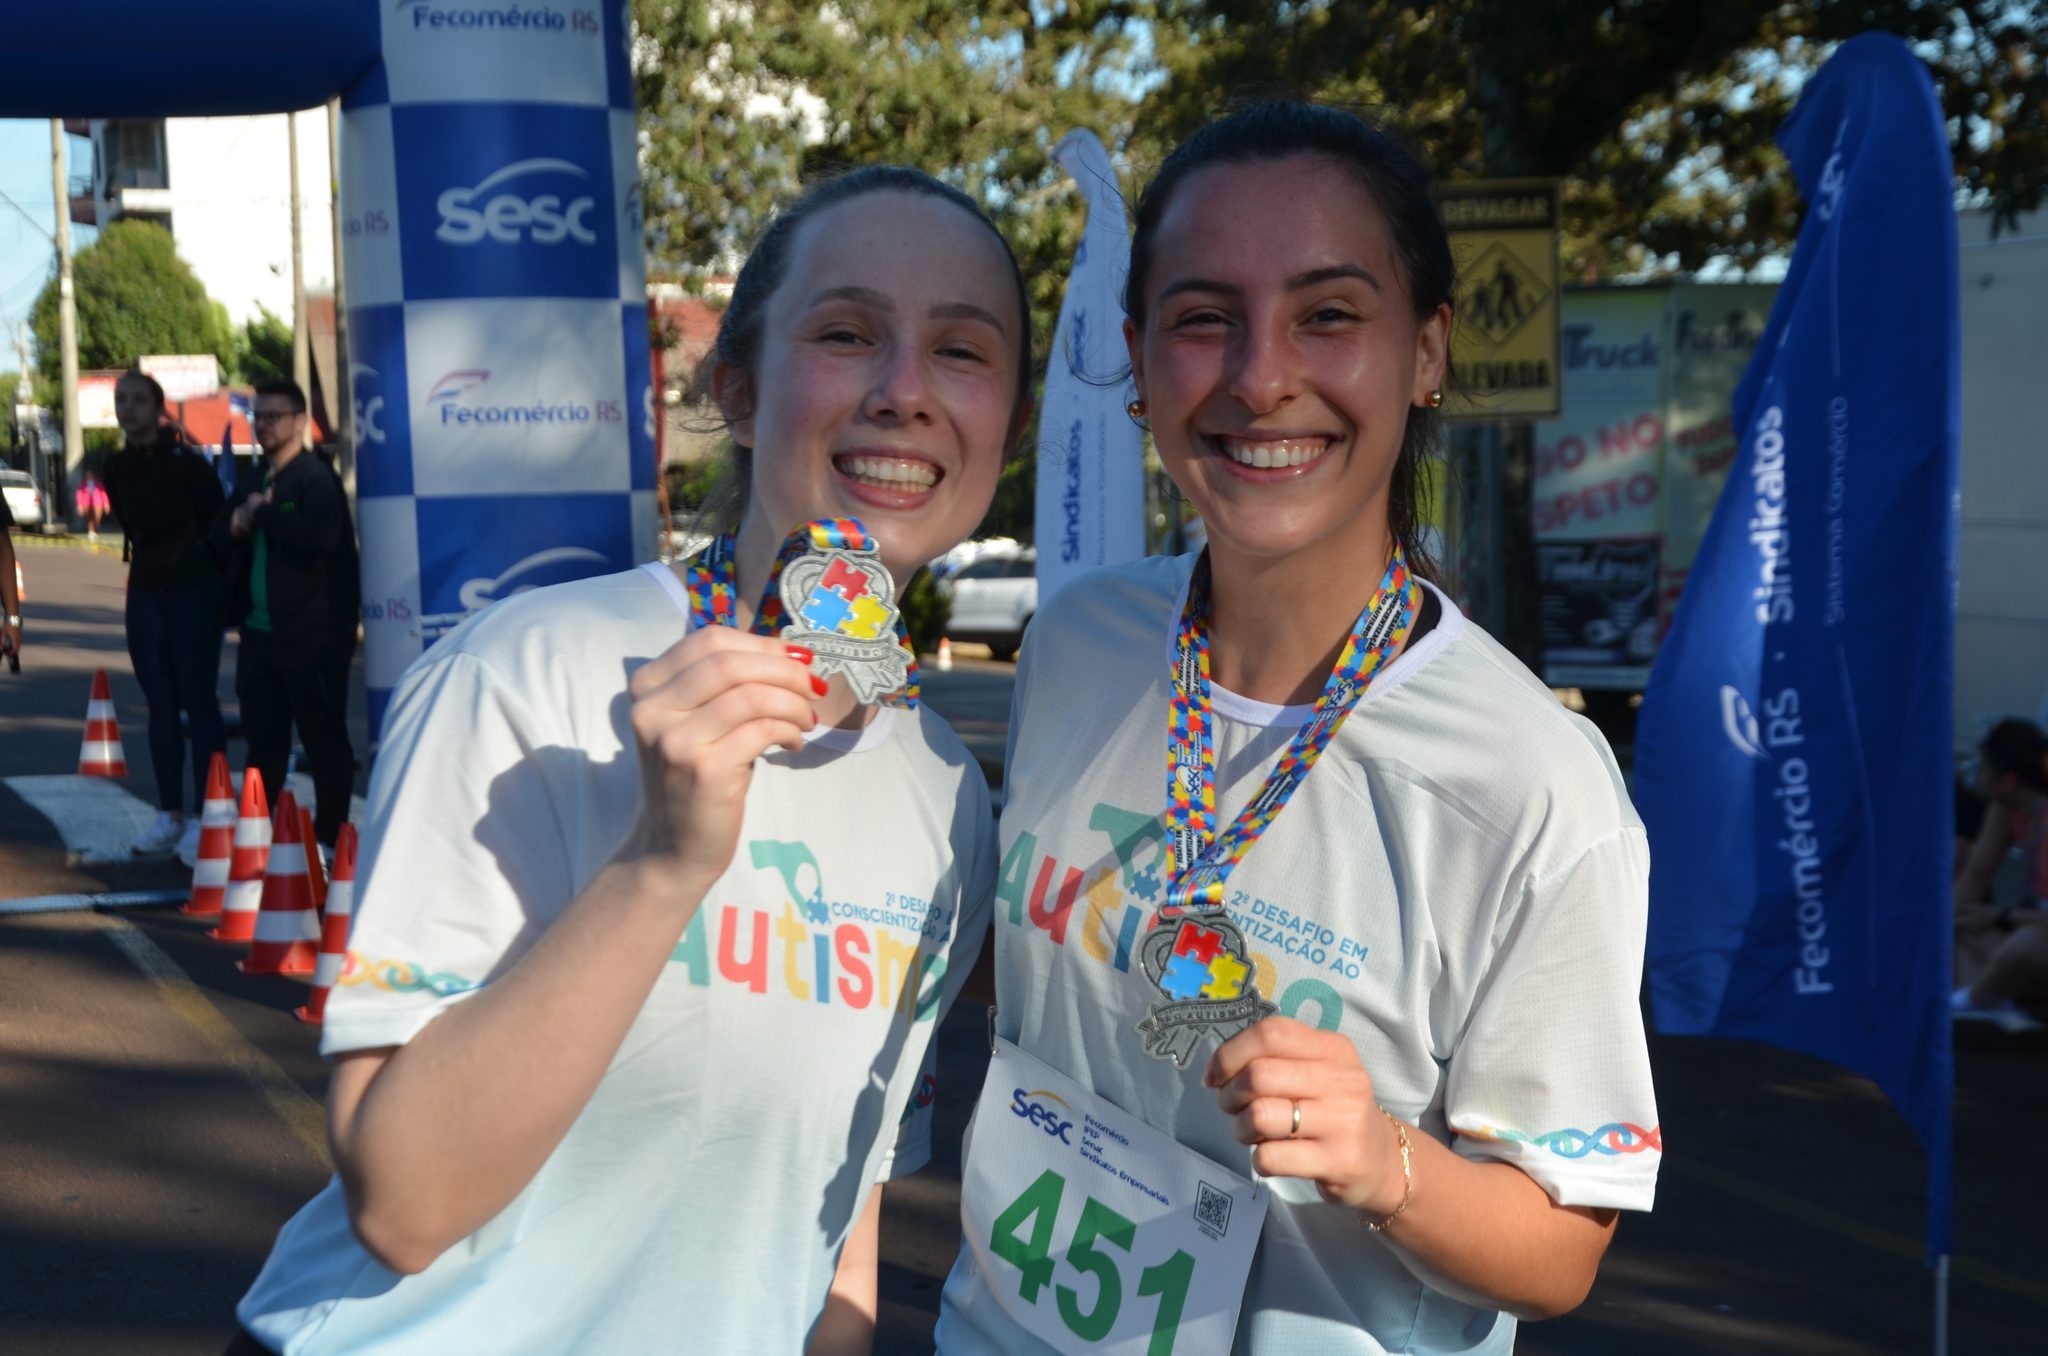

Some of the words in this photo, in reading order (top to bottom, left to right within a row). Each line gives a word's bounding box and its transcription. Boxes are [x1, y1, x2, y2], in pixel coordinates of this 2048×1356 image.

[413, 5, 565, 31] Fecomércio
[571, 9, 599, 34] RS
[364, 210, 390, 234] RS
[1563, 323, 1660, 369] Truck
[441, 400, 590, 427] Fecomércio
[597, 402, 623, 424] RS
[1827, 396, 1848, 511] Comércio
[1061, 418, 1083, 563] Sindicatos
[1750, 405, 1795, 626] Sindicatos
[1826, 522, 1845, 627] Sistema
[386, 597, 413, 620] RS
[1765, 687, 1802, 747] RS
[1774, 756, 1833, 996] Fecomércio
[1254, 899, 1337, 947] DESAFIO
[1338, 937, 1370, 962] EM
[1329, 955, 1361, 980] AO
[1187, 1005, 1249, 1020] AUTISMO
[1009, 1088, 1074, 1146] Sesc
[989, 1167, 1197, 1356] 451
